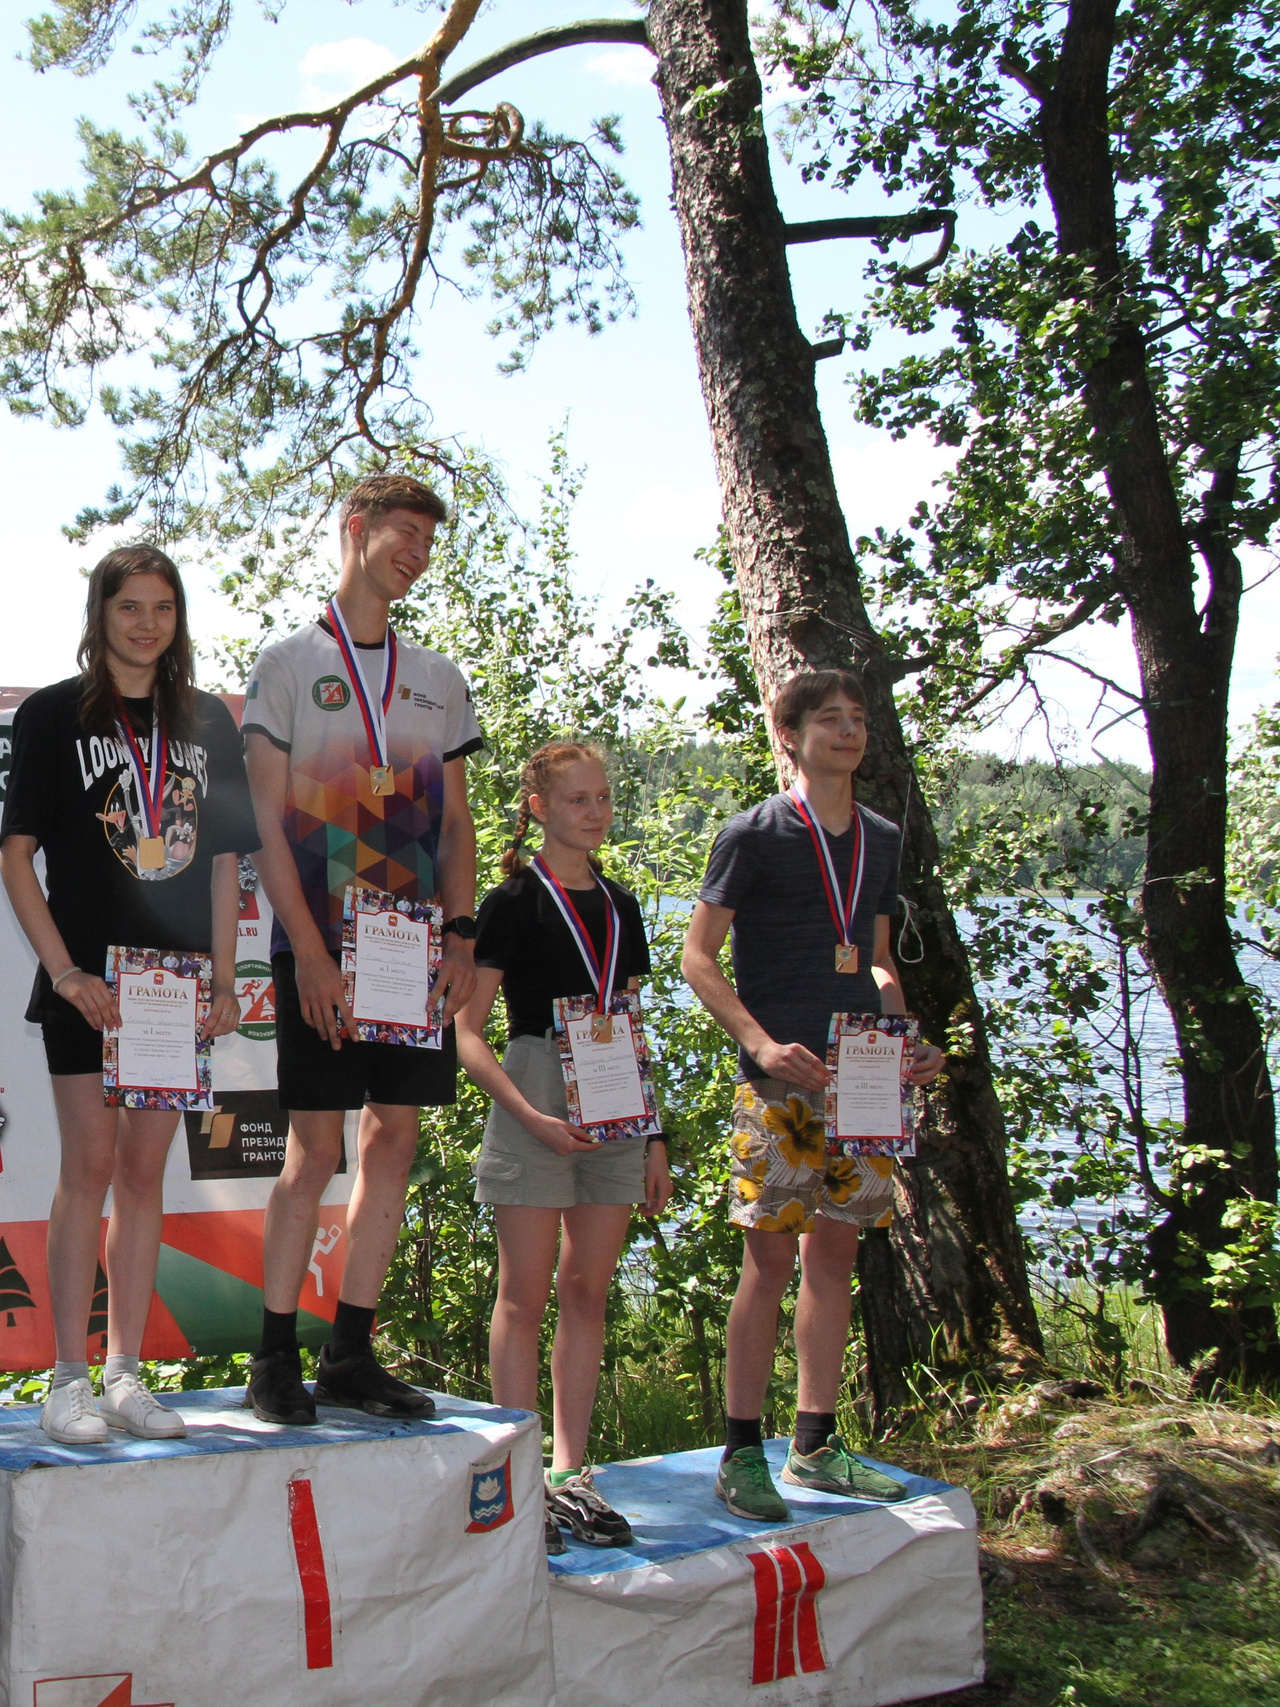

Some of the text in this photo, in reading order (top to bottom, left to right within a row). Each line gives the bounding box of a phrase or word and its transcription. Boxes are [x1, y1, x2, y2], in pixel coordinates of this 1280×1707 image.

[75, 735, 149, 791] LOONY
[364, 924, 421, 942] ГРАМОТА
[236, 963, 271, 973] СПОРТИВНО
[128, 985, 188, 999] ГРАМОТА
[846, 1045, 895, 1055] ГРАМОТА
[240, 1123, 272, 1133] ФОНД
[243, 1151, 286, 1162] ГРАНТО
